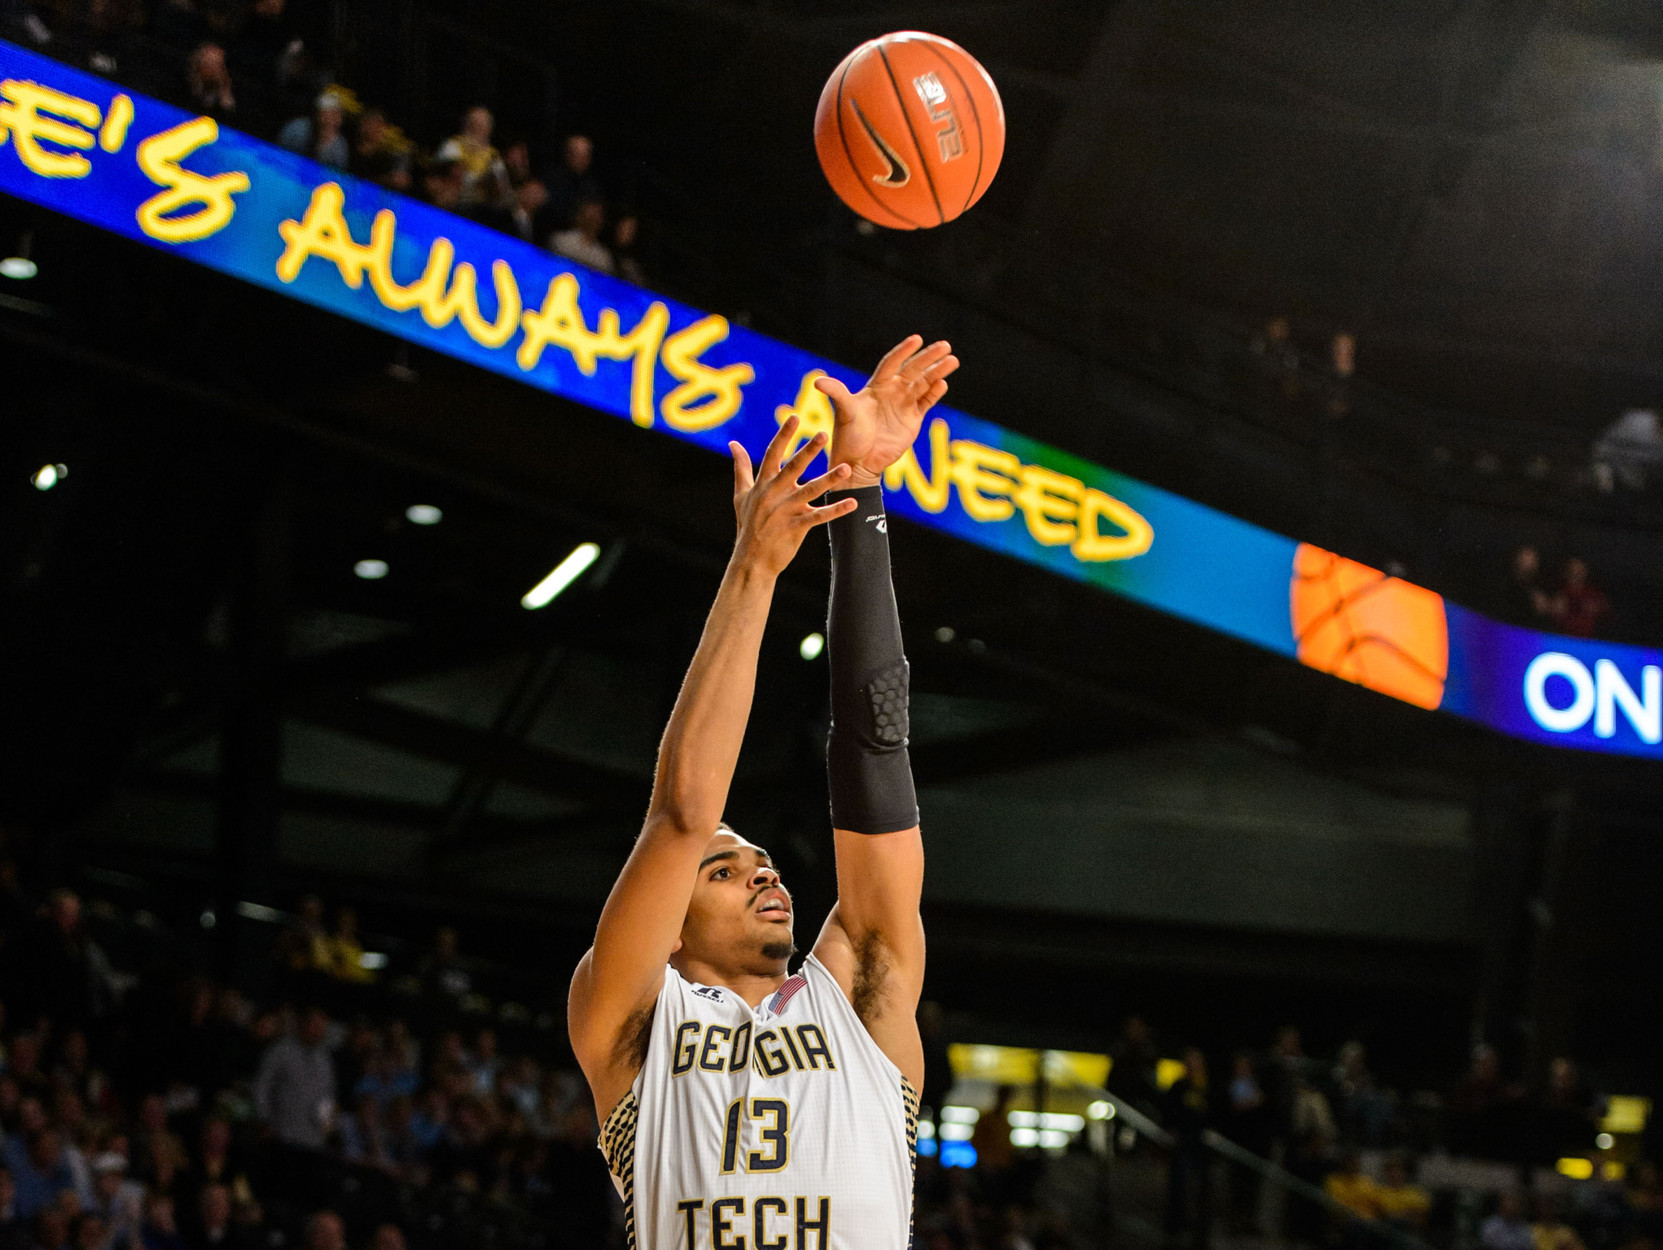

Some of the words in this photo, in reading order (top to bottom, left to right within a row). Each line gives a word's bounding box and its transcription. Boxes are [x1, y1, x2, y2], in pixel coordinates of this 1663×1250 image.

[0, 78, 250, 244] E'S
[276, 182, 755, 429] ALWAYS
[884, 417, 1155, 562] NEED
[1523, 651, 1663, 745] ON
[671, 1019, 838, 1080] GEOGIA
[719, 1096, 791, 1176] 13
